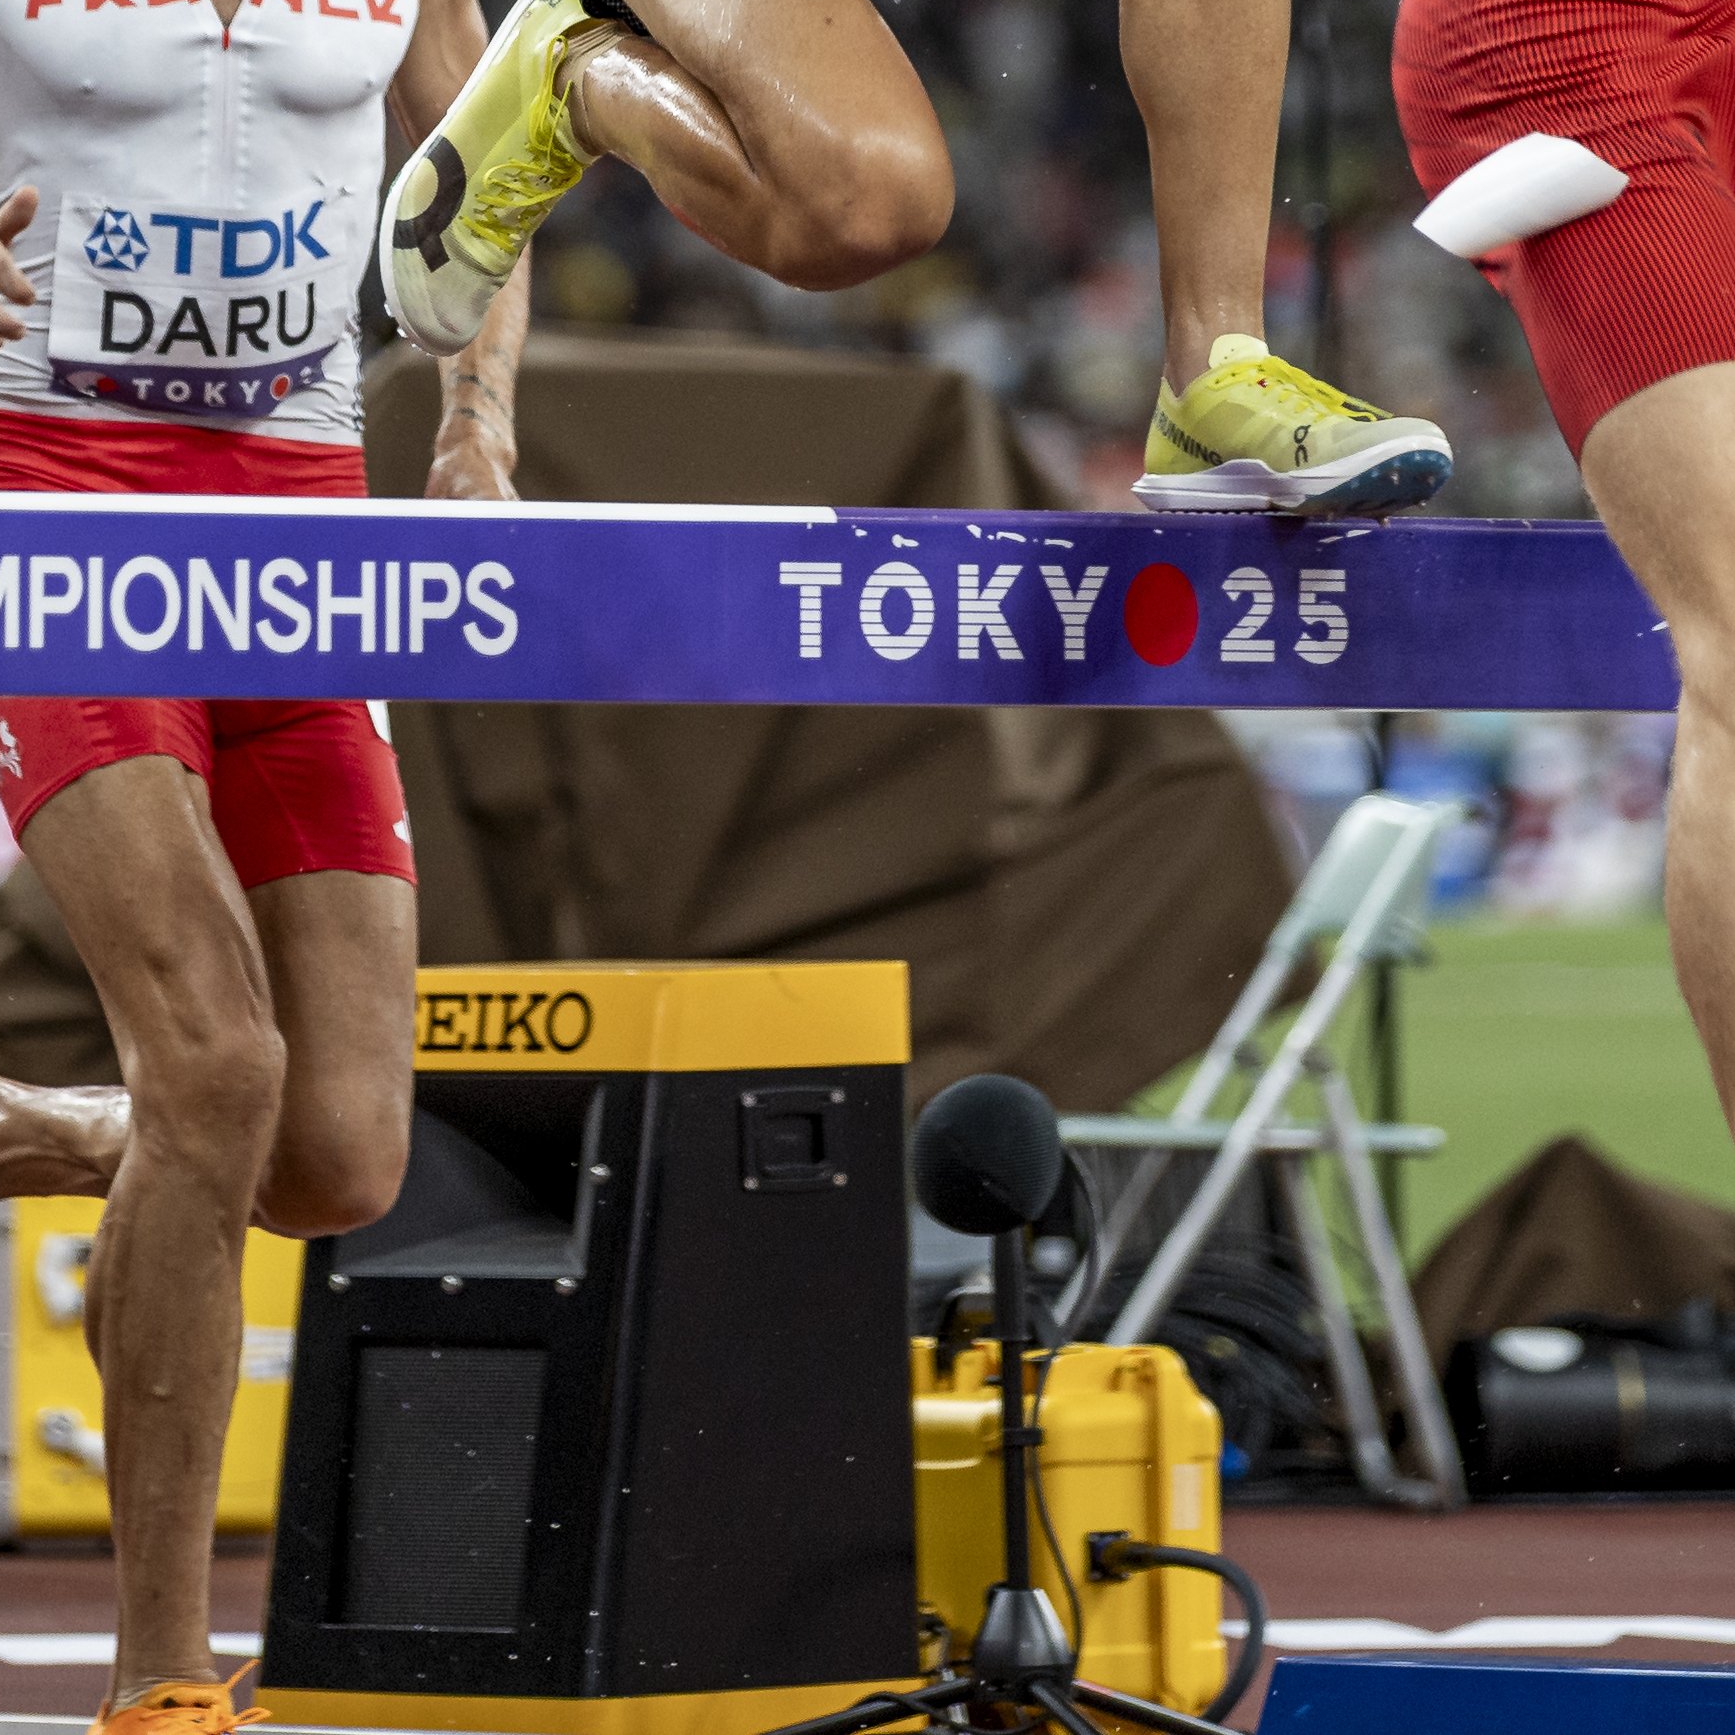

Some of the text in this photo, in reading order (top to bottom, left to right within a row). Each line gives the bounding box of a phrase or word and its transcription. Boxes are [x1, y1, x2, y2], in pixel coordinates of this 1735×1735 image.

[150, 200, 330, 279] TDK
[100, 282, 316, 357] DARU
[1220, 566, 1351, 665] 25
[417, 991, 593, 1054] EIKO
